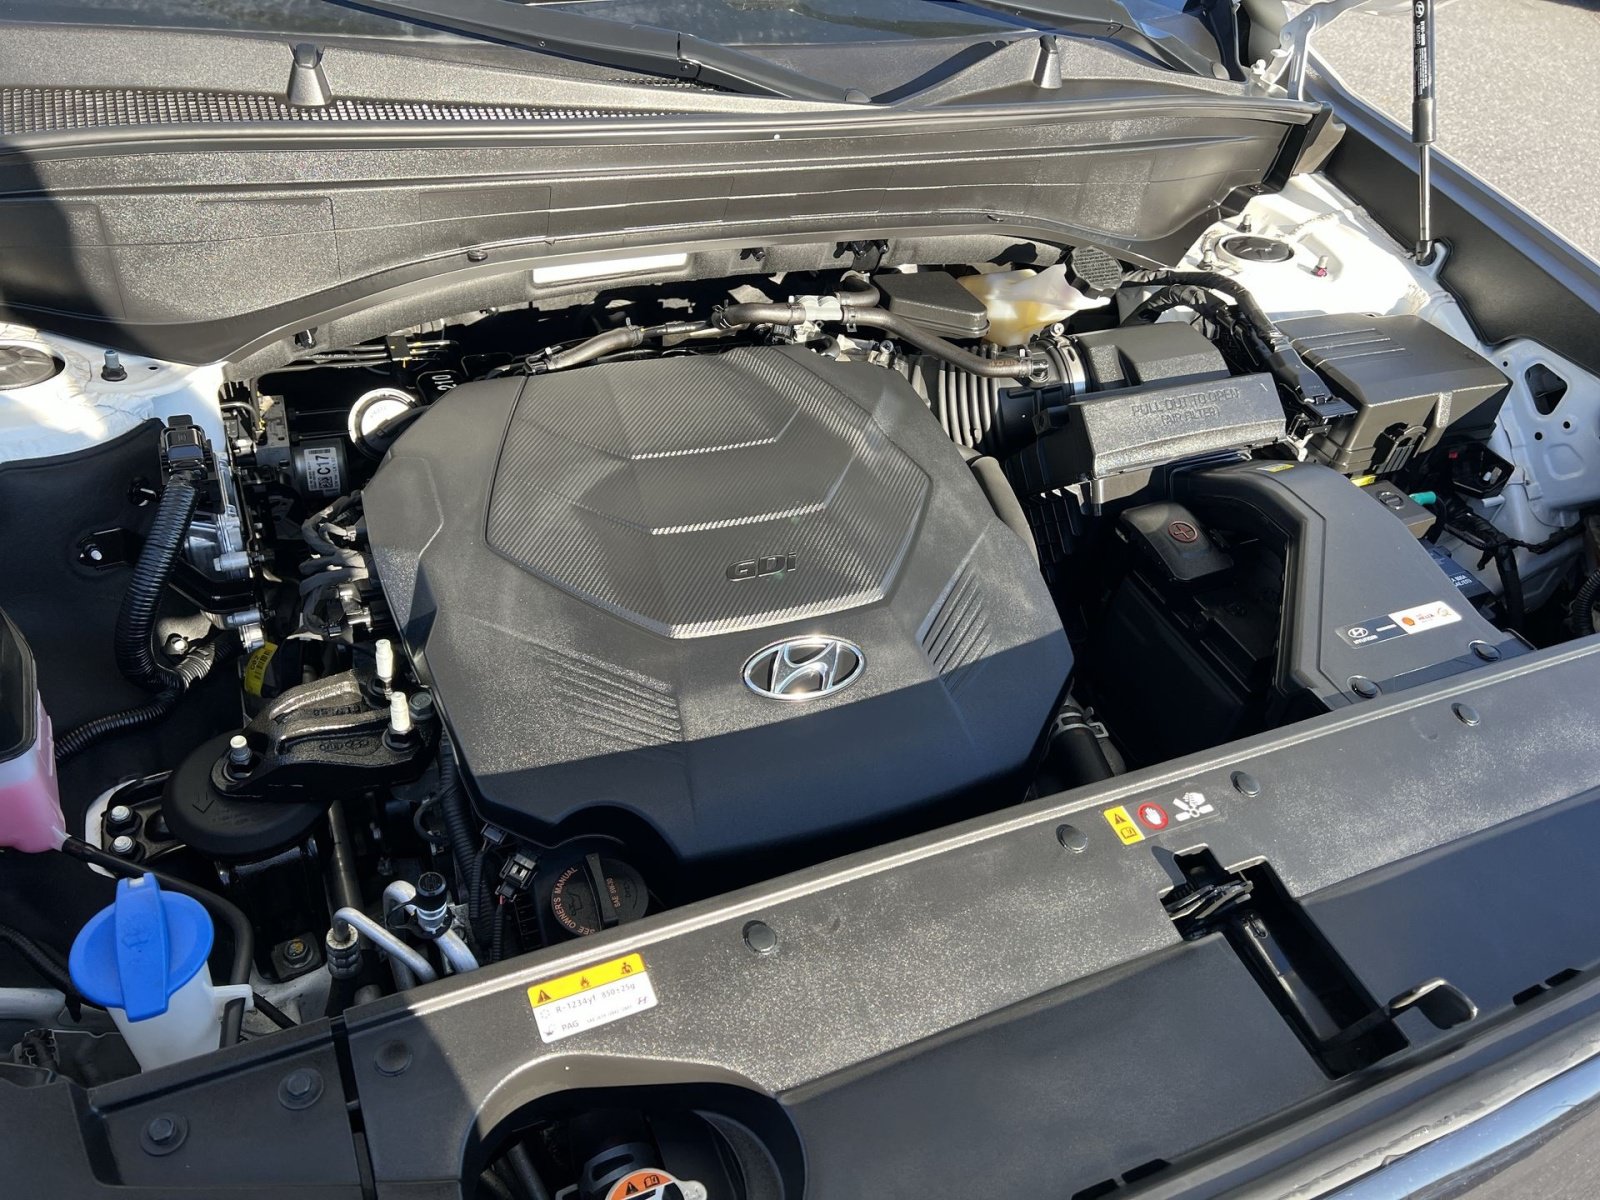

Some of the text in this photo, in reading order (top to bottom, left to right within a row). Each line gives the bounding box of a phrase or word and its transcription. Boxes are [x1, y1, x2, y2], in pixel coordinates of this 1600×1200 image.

[1131, 387, 1240, 416] PULL OUT TO OPEN
[1184, 404, 1220, 421] FILTER)
[315, 455, 331, 475] C17
[726, 552, 797, 581] GDi
[554, 867, 596, 935] SEE OWNER'S MANUAL
[611, 895, 620, 908] SAE
[555, 994, 596, 1013] R-1234yf
[561, 1019, 580, 1031] PAG
